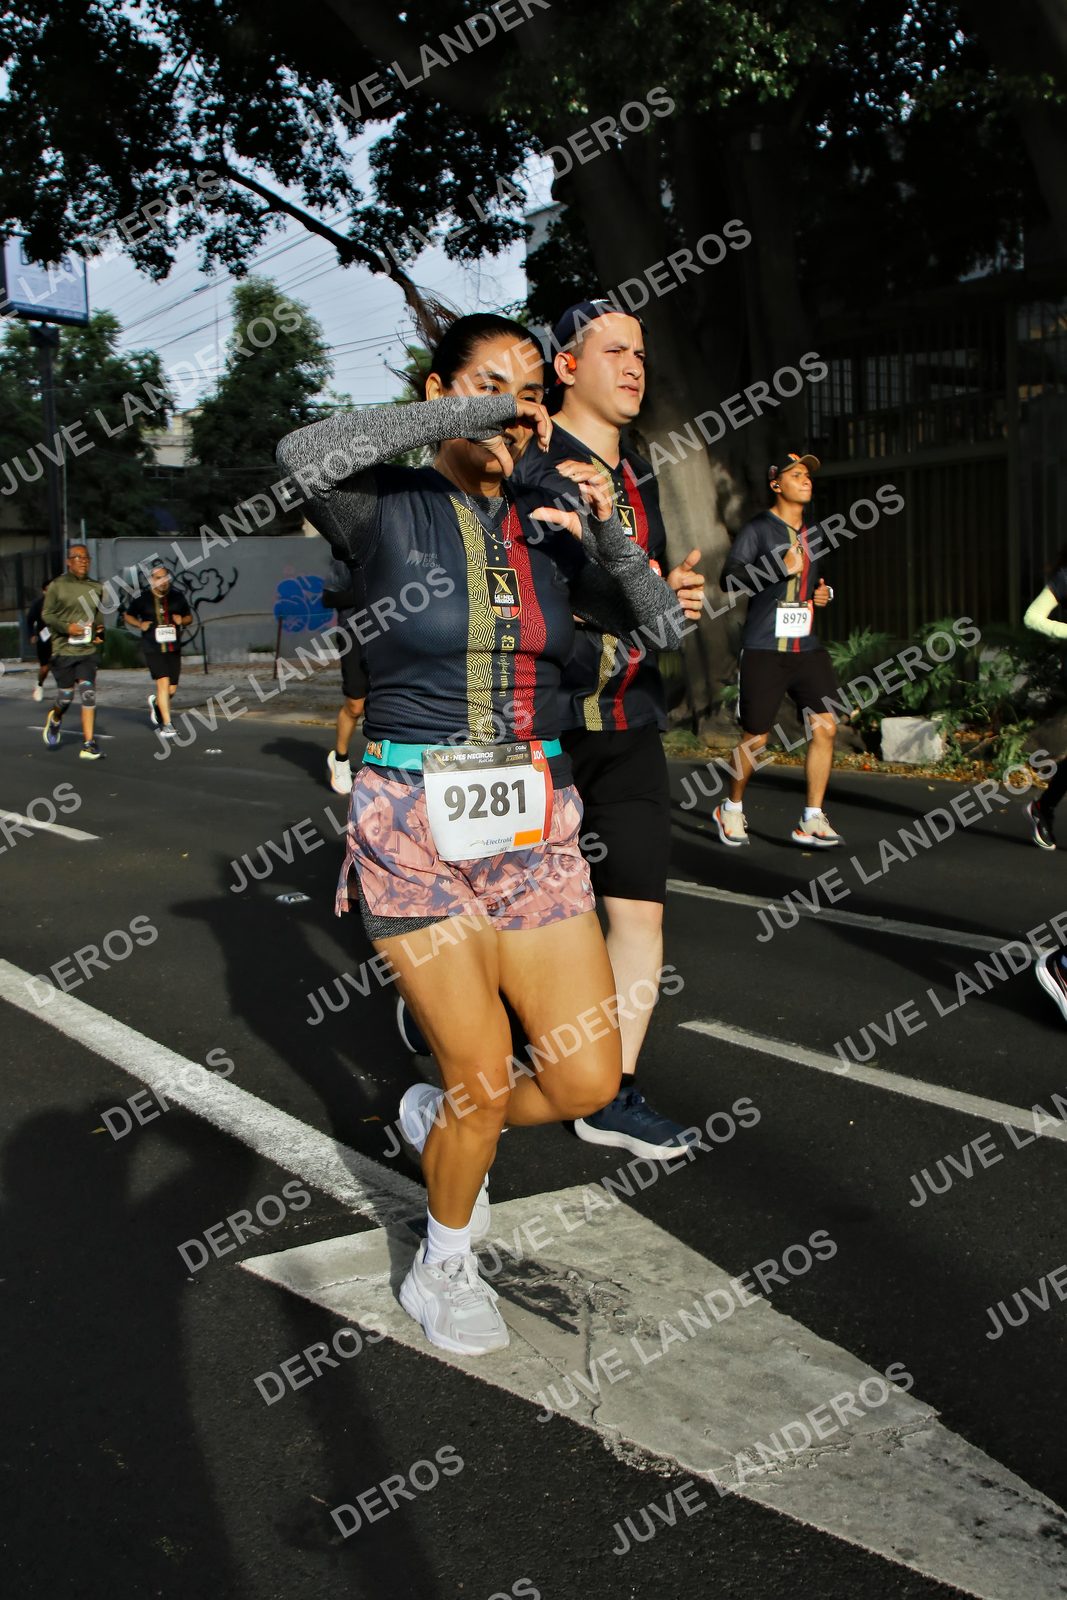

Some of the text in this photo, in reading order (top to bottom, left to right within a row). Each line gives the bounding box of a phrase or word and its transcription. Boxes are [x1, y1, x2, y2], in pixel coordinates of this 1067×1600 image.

[782, 612, 808, 625] 8979
[467, 751, 494, 760] NEGROS
[443, 779, 527, 822] 9281
